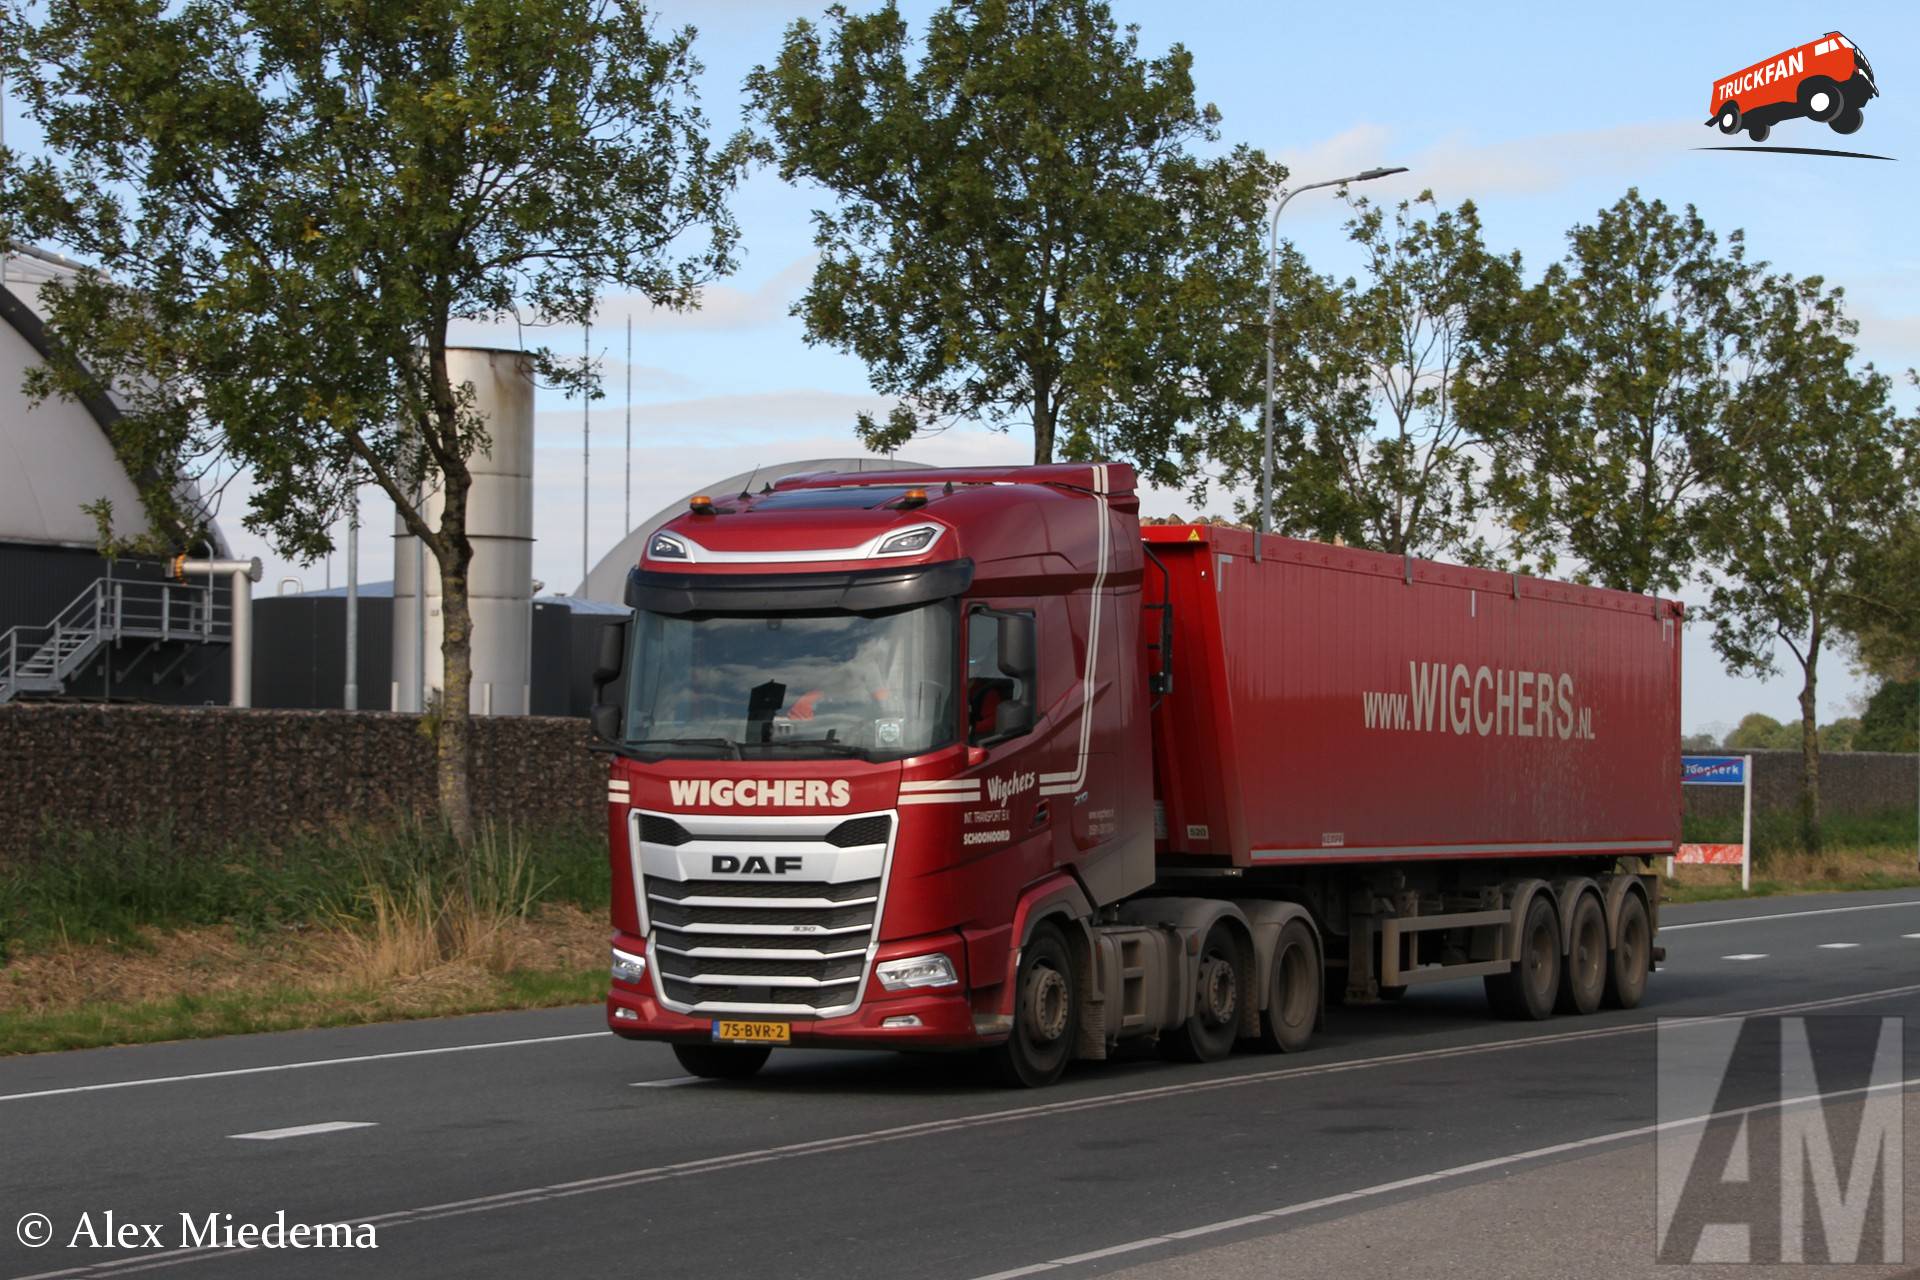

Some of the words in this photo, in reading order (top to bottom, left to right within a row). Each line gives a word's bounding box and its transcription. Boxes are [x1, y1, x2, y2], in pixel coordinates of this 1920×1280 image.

[669, 779, 850, 808] WIGCHERS
[987, 771, 1035, 807] Wigchers
[963, 830, 1011, 845] SCHOONOORD
[712, 855, 803, 874] DAF
[723, 1022, 785, 1039] 75-BVR-2
